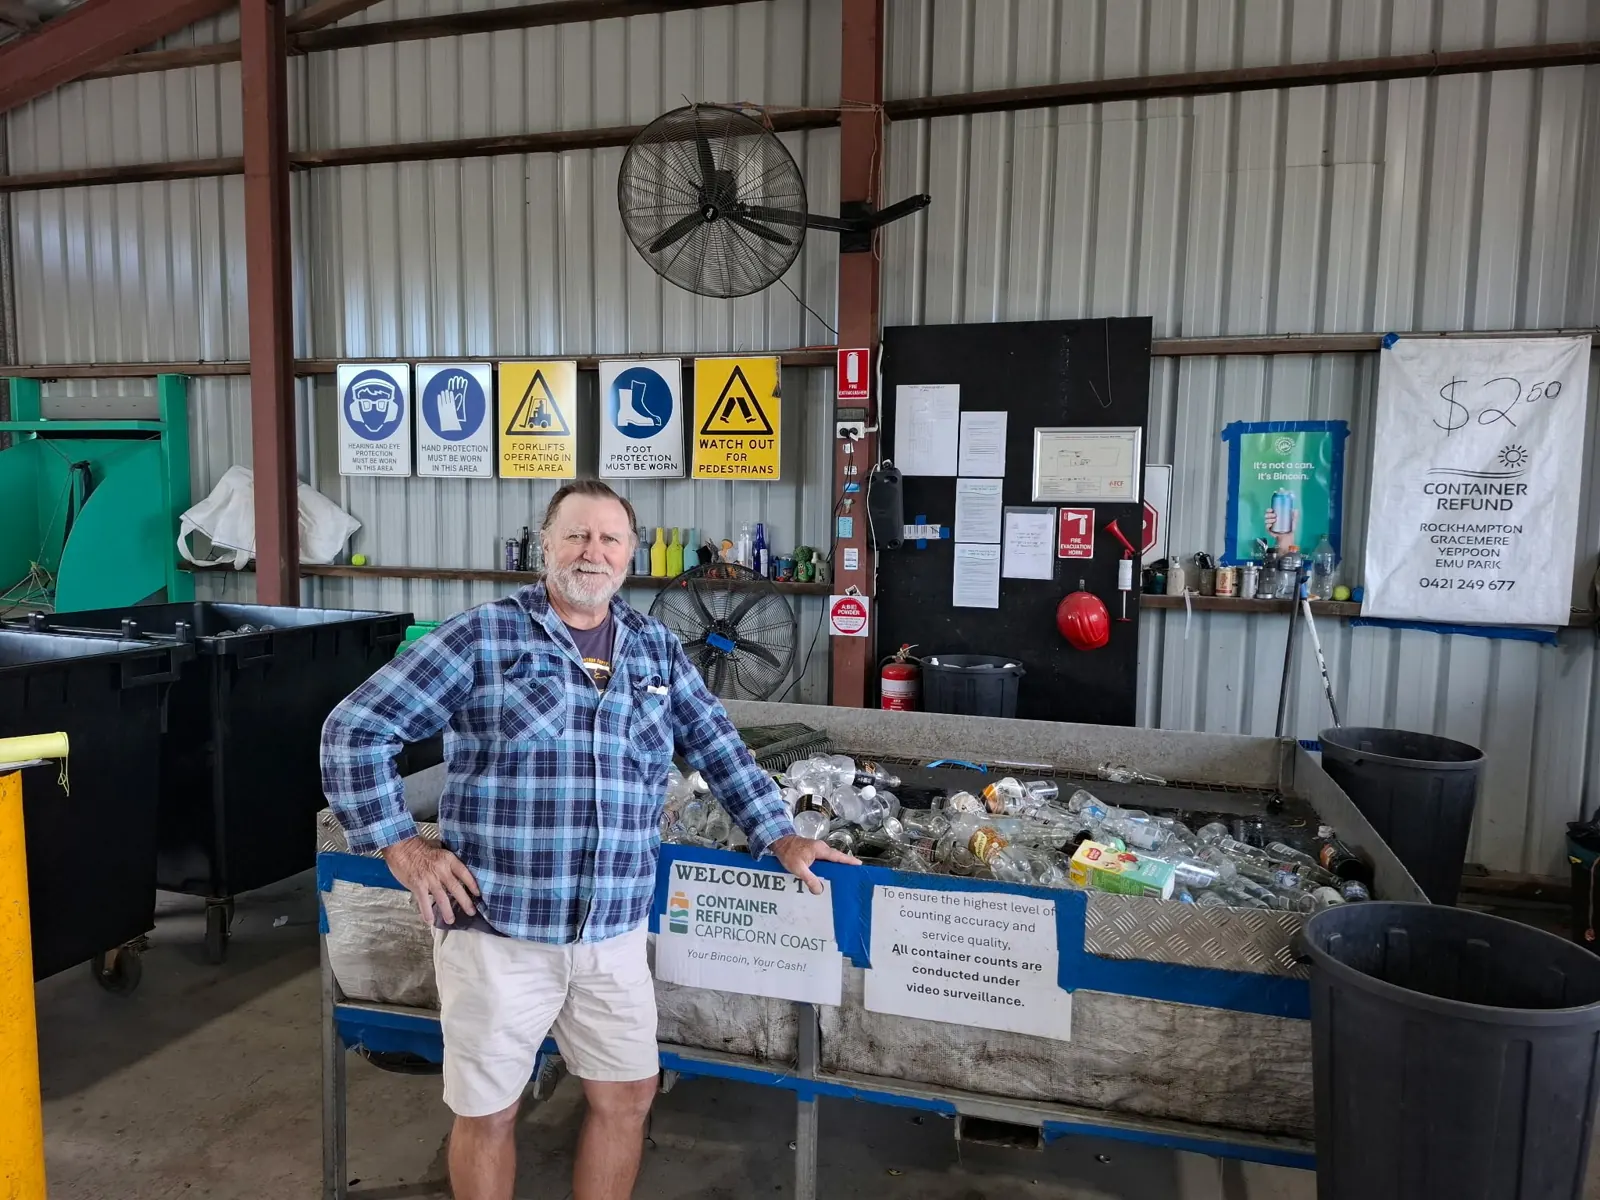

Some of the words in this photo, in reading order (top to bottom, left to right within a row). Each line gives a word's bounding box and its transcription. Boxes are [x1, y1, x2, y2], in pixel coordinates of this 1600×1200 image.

[512, 443, 565, 451] FORKLIFTS
[700, 439, 743, 449] WATCH
[749, 439, 774, 449] OUT
[726, 453, 747, 461] FOR
[699, 465, 774, 473] PEDESTRIANS
[1273, 472, 1310, 480] Bincoin.
[1424, 483, 1528, 495] CONTAINER
[1437, 498, 1513, 510] REFUND
[1420, 523, 1522, 533] ROCKHAMPTON
[1430, 535, 1509, 545] GRACEMERE
[1438, 547, 1500, 557] YEPPOON
[1436, 559, 1464, 568] EMU
[1468, 560, 1501, 569] PARK
[1420, 578, 1453, 588] 0421
[1457, 579, 1484, 590] 249
[1488, 580, 1515, 591] 677
[675, 864, 786, 891] WELCOME
[696, 894, 778, 915] CONTAINER
[882, 888, 895, 899] To
[898, 891, 938, 903] ensure
[941, 894, 960, 906] the
[964, 897, 1007, 912] highest
[1012, 902, 1039, 915] level
[1043, 906, 1056, 916] of
[696, 910, 753, 926] REFUND
[900, 908, 951, 925] counting
[954, 916, 1010, 932] accuracy
[1012, 922, 1036, 933] and
[695, 924, 776, 945] CAPRICORN
[780, 934, 827, 952] COAST
[922, 931, 964, 943] service
[968, 936, 1011, 950] quality,
[687, 949, 709, 960] Your
[710, 952, 750, 965] Bincoin,
[753, 956, 775, 968] Your
[777, 959, 806, 972] Cash!
[892, 943, 908, 955] All
[911, 947, 971, 962] container
[974, 954, 1018, 969] counts
[1022, 961, 1042, 972] are
[912, 964, 979, 982] conducted
[983, 974, 1020, 986] under
[906, 982, 940, 996] video
[943, 990, 1025, 1007] surveillance.
